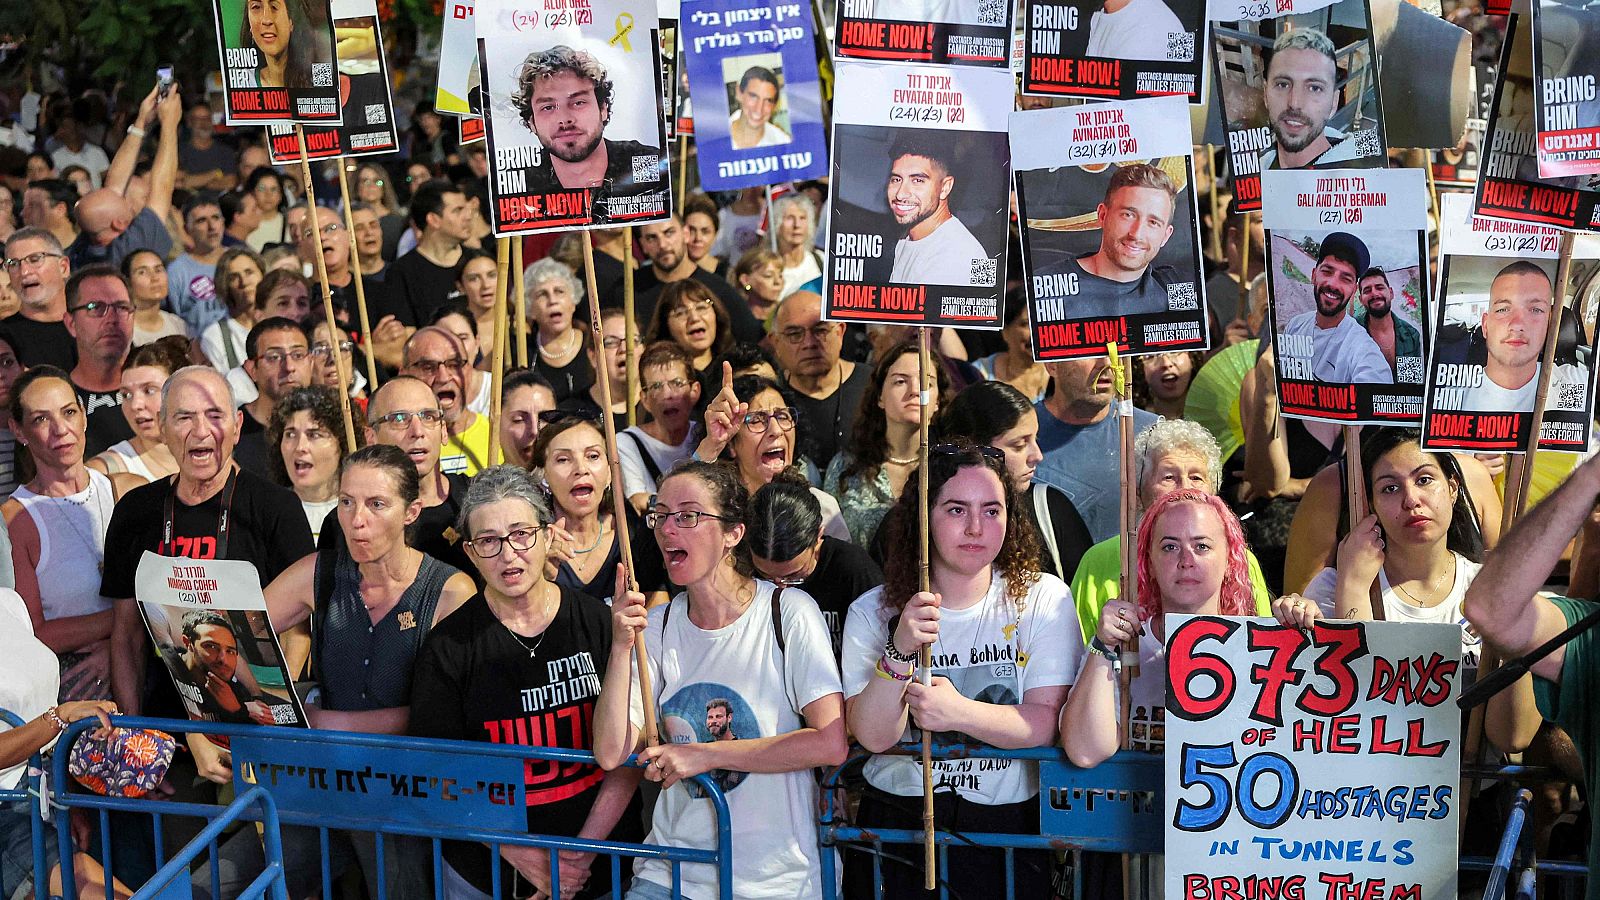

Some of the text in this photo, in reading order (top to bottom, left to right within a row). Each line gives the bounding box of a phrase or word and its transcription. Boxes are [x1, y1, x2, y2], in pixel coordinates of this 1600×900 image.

[512, 10, 539, 32] (24)
[691, 4, 800, 27] אין ניצחון בלי
[844, 0, 874, 19] HIM
[1032, 4, 1079, 30] BRING
[693, 27, 804, 54] סגן הדר גולדין
[841, 21, 935, 51] HOME NOW!
[948, 35, 973, 46] HOSTAGES
[1031, 30, 1061, 55] HIM
[226, 48, 258, 68] BRING
[947, 44, 979, 57] FAMILIES
[979, 46, 1005, 58] FORUM
[229, 69, 249, 88] HER
[907, 74, 951, 90] אביתר דוד
[1030, 57, 1121, 87] HOME NOW!
[1136, 72, 1195, 81] HOSTAGES AND MISSING
[893, 89, 962, 106] EVYATAR DAVID
[1136, 80, 1195, 93] FAMILIES FORUM
[1542, 74, 1596, 105] BRING
[231, 89, 290, 110] HOME NOW!
[947, 107, 965, 123] (22)
[1075, 109, 1124, 126] אבינתן אור
[1544, 103, 1578, 131] HIM
[273, 134, 300, 154] HOM
[306, 128, 339, 151] NOW!
[1073, 124, 1131, 142] AVINATAN OR
[1229, 126, 1271, 152] BRING
[495, 145, 542, 171] BRING
[781, 151, 812, 170] עוז
[1232, 151, 1261, 176] HIM
[1487, 152, 1520, 179] HIM
[498, 170, 527, 195] HIM
[1235, 176, 1262, 200] HO
[1352, 177, 1366, 191] גלי
[499, 188, 592, 221] HOME NOW!
[608, 201, 664, 216] FAMILIES FORUM
[1297, 192, 1387, 207] GALI AND ZIV BERMAN
[1481, 180, 1528, 209] HOME
[1530, 187, 1579, 218] NOW!
[1319, 210, 1342, 224] (27)
[1472, 218, 1490, 232] BAR
[1493, 220, 1539, 234] ABRAHAM
[836, 233, 883, 258] BRING
[834, 258, 864, 281] HIM
[1033, 273, 1079, 299] BRING
[833, 284, 926, 312] HOME NOW!
[941, 296, 965, 306] HOSTAGES
[975, 298, 997, 307] MISSING
[941, 305, 997, 318] FAMILIES FORUM
[1036, 298, 1065, 322] HIM
[1038, 316, 1128, 348] HOME NOW!
[1144, 322, 1167, 333] HOSTAGES
[1178, 320, 1200, 330] MISSING
[1144, 328, 1201, 343] FAMILIES FORUM
[1277, 333, 1315, 357] BRING
[1279, 356, 1314, 381] THEM
[1435, 364, 1484, 388] BRING
[1281, 382, 1357, 410] HOME NOW!
[1372, 394, 1396, 403] HOSTAGES
[1432, 387, 1465, 411] HIM
[1373, 402, 1423, 415] FAMILIES FORU
[1430, 412, 1520, 439] HOME NOW!
[1557, 430, 1583, 441] FORUM
[1561, 422, 1584, 431] MISSING
[167, 577, 218, 591] NIMROD COHEN
[178, 591, 197, 604] (20)
[994, 666, 1013, 677] 673
[1165, 616, 1460, 728] 673 DAYS
[521, 681, 568, 712] הביתה
[1241, 714, 1451, 757] OF HELL
[957, 760, 973, 772] MY
[939, 772, 982, 791] HOME
[1172, 741, 1453, 832] 50 HOSTAGES
[1208, 836, 1415, 866] IN TUNNELS
[1183, 872, 1423, 900] BRING THEM
